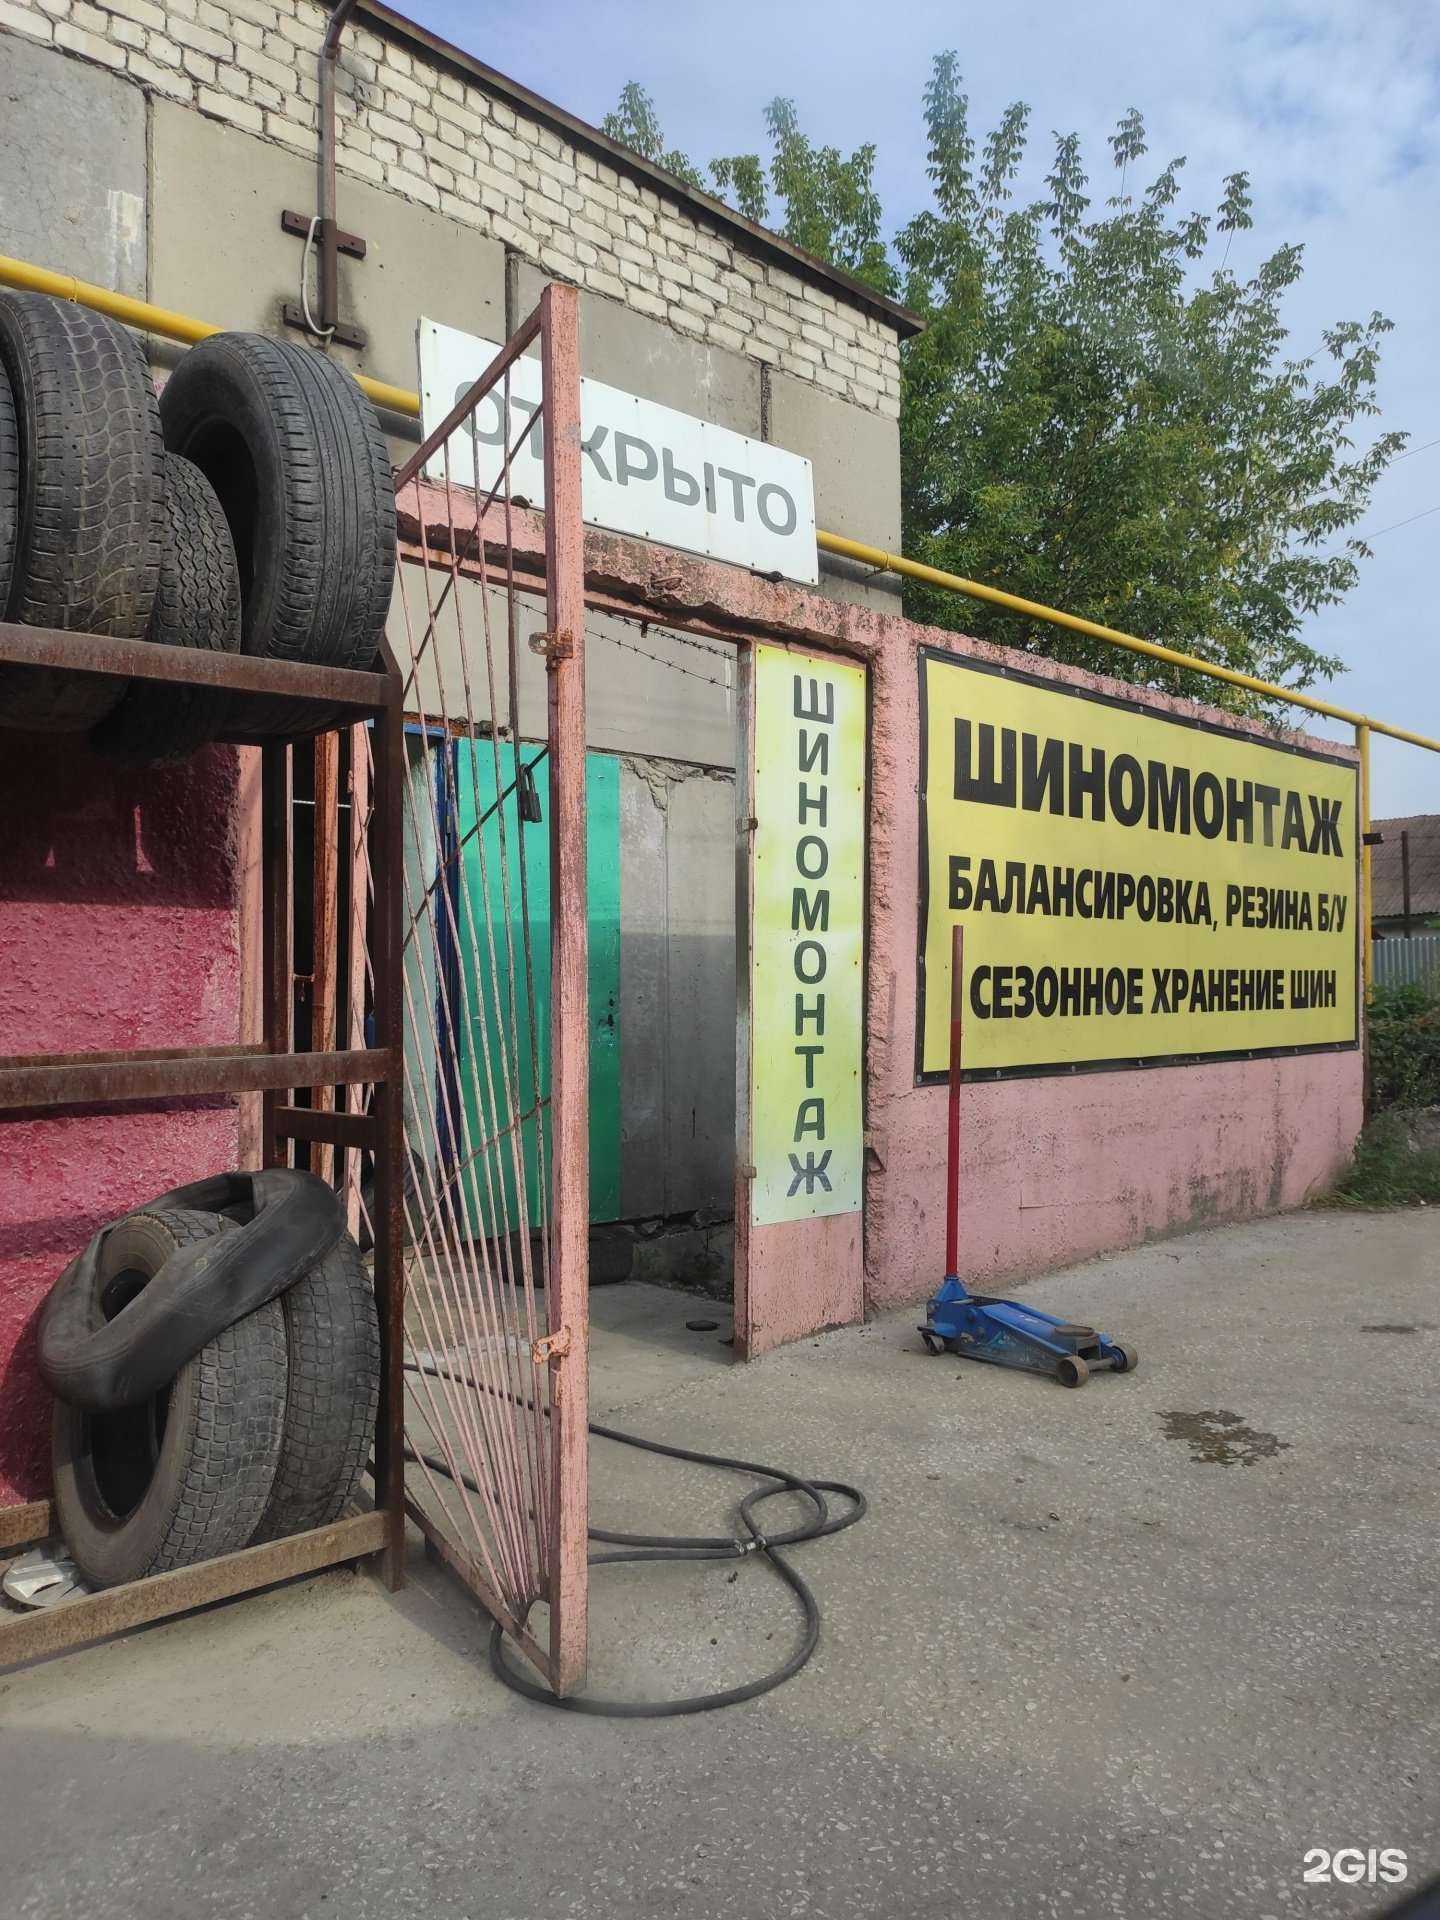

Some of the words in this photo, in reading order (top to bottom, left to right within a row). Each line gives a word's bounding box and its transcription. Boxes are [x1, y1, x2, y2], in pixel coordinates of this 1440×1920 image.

[455, 381, 797, 536] ОТКРЫТО
[953, 717, 1344, 858] ШИНОМОНТАЖ
[786, 674, 835, 1198] ШИНОМОНТАЖ
[948, 855, 1219, 932] БАЛАНСИРОВКА,
[1225, 884, 1313, 931] РЕЗИНА
[1317, 893, 1348, 933] Б/У
[969, 965, 1144, 1019] СЕЗОННОЕ
[1150, 968, 1285, 1015] ХРАНЕНИЕ
[1290, 969, 1337, 1009] ШИН
